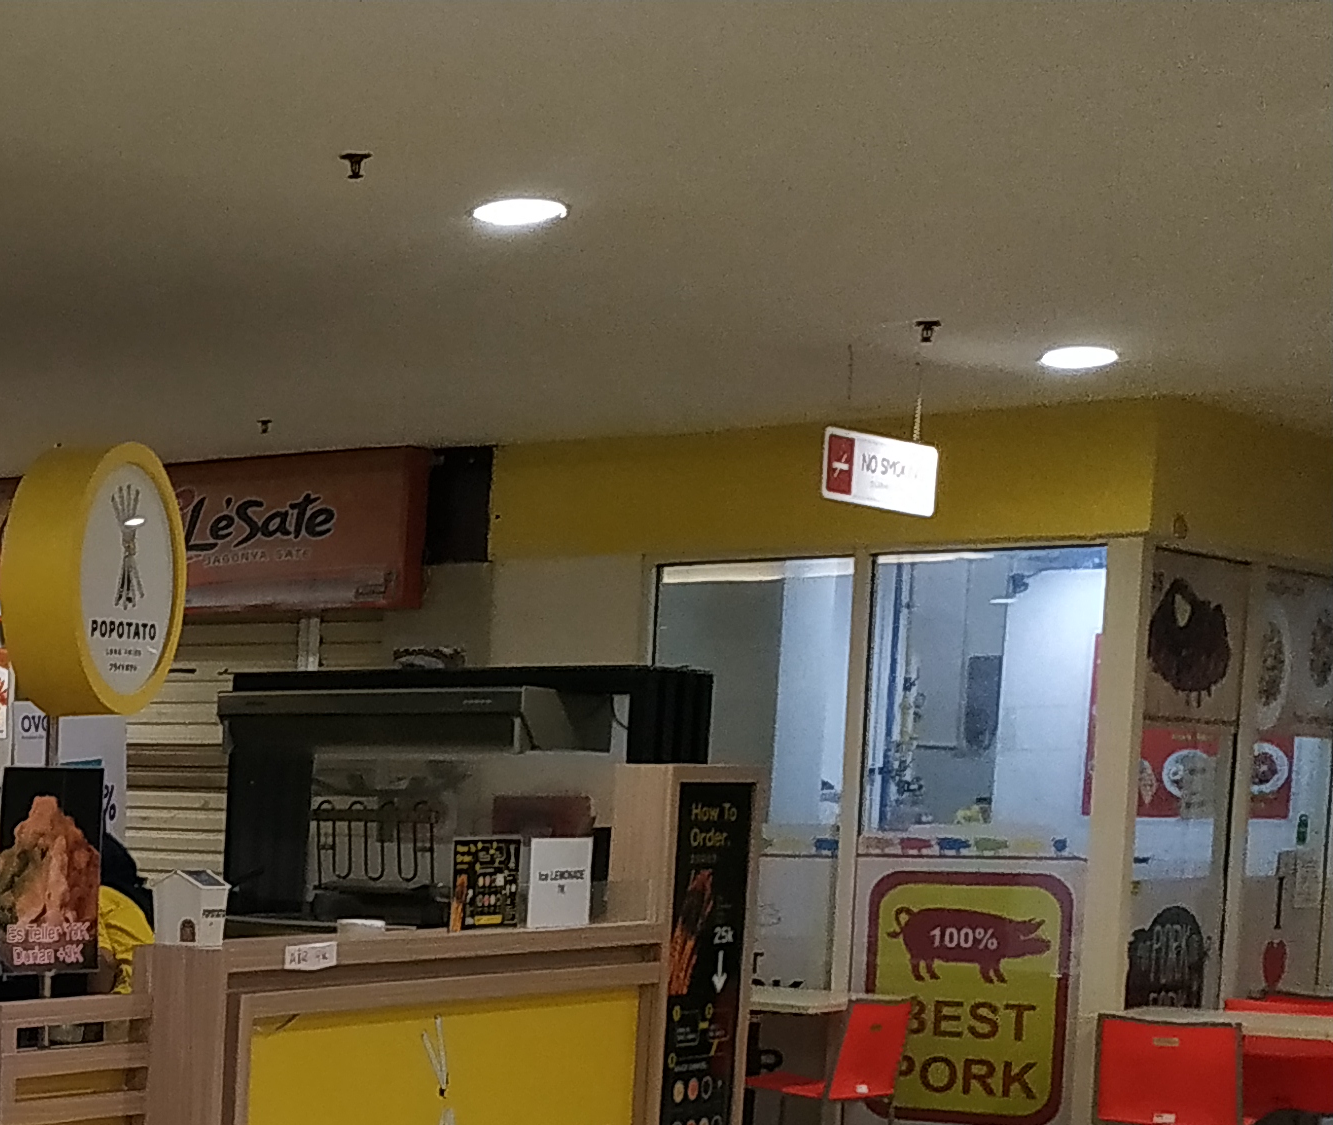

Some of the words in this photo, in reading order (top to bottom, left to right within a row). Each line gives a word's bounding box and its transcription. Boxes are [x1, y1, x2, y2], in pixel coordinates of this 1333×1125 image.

[91, 619, 157, 641] POPOTATO
[691, 802, 718, 821] How
[723, 802, 738, 821] To
[25, 923, 63, 942] Teller
[929, 926, 998, 951] 100%
[13, 945, 55, 966] Durian
[907, 996, 1037, 1043] BEST
[898, 1054, 1039, 1100] PORK
